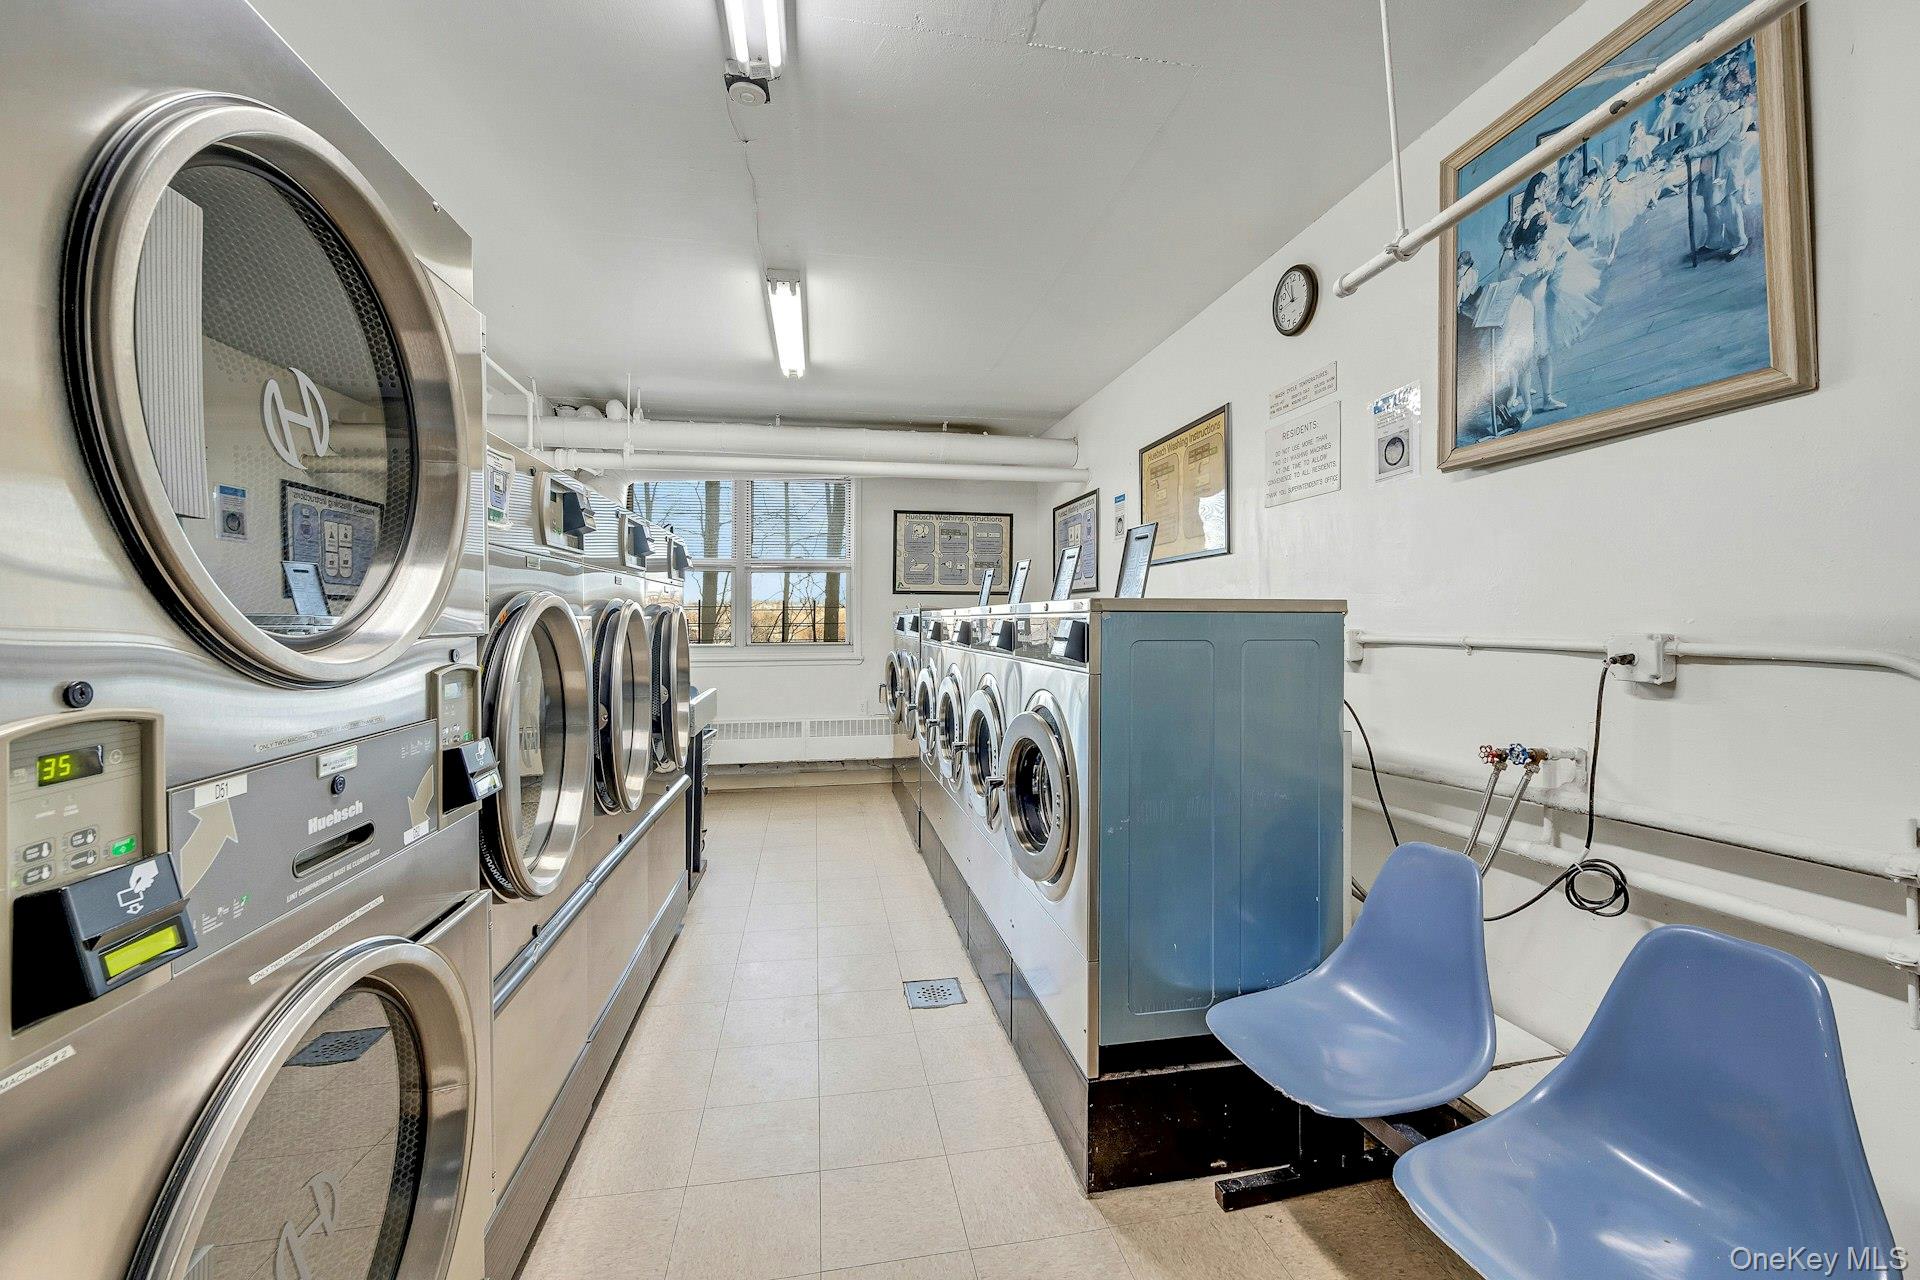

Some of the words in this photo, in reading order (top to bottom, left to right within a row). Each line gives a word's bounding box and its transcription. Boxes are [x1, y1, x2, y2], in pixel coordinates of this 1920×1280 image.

[1189, 421, 1221, 443] Instructions
[1301, 437, 1313, 448] MORE
[1315, 432, 1327, 443] THAN
[1312, 452, 1327, 464] ALLOW
[1302, 467, 1310, 476] ALL
[935, 514, 963, 522] Washing
[965, 514, 1003, 523] Instructions
[43, 754, 71, 780] 35
[215, 781, 228, 799] D51
[308, 800, 363, 835] Huebsch
[286, 891, 298, 903] LINT
[299, 872, 334, 896] COMPARTMENT
[334, 866, 346, 878] MUST
